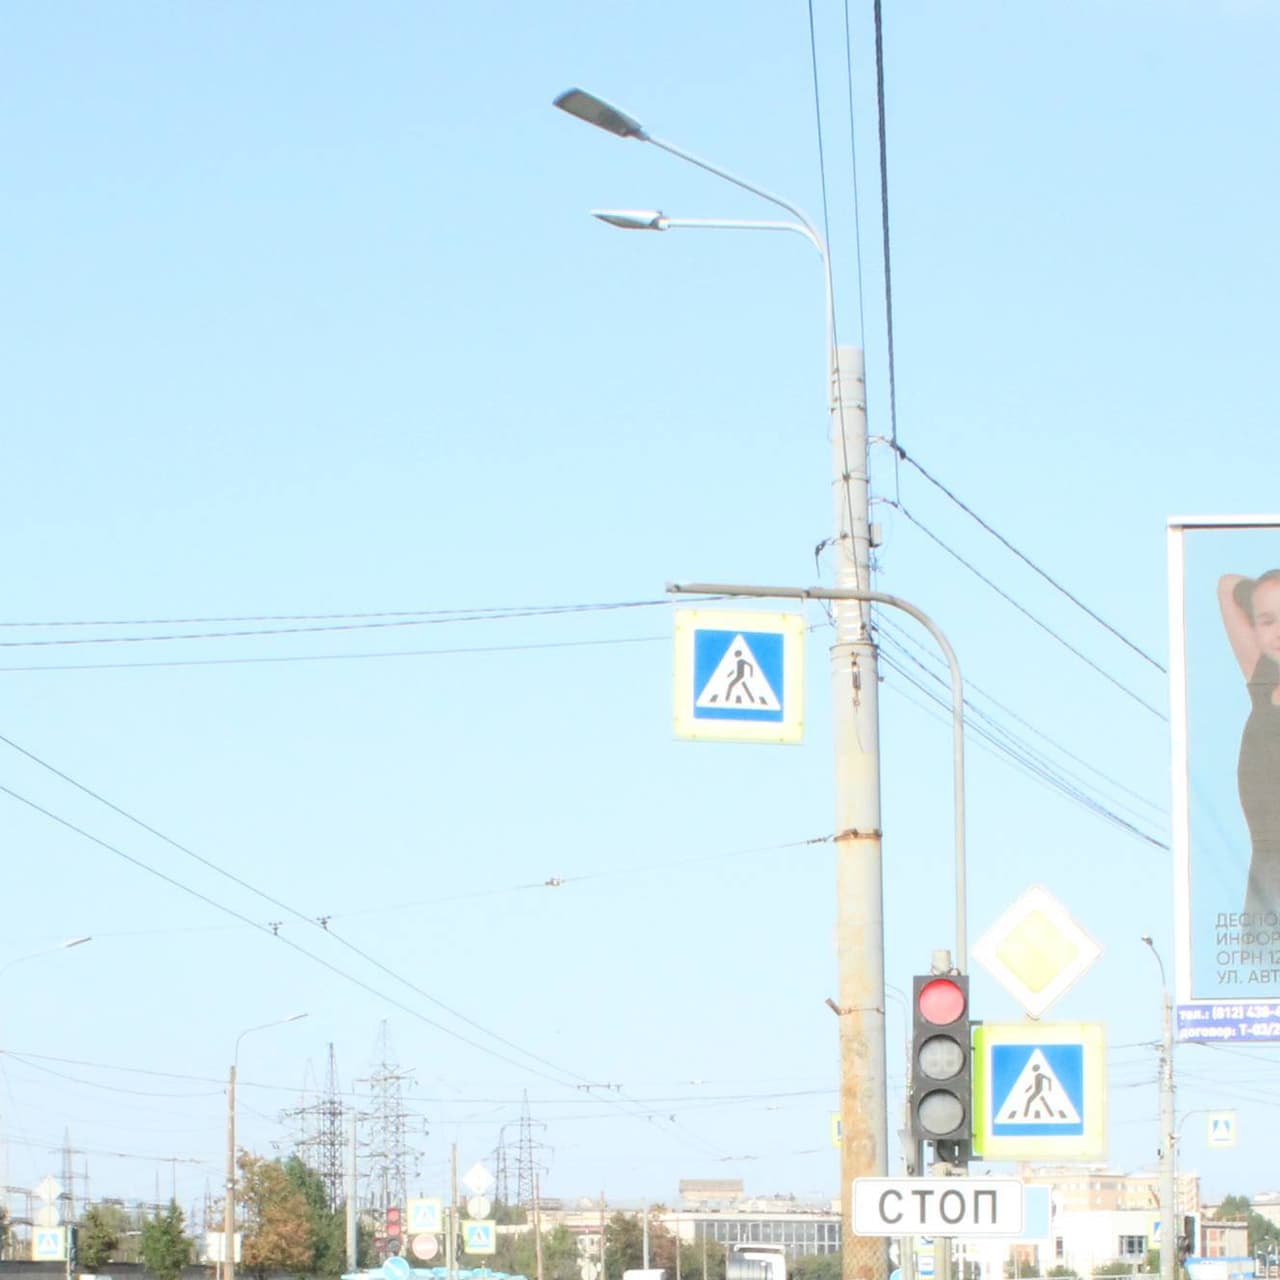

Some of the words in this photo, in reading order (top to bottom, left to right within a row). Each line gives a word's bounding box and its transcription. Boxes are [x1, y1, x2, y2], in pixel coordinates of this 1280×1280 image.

[1216, 950, 1263, 966] ОГРН
[1217, 969, 1242, 985] УЛ.
[879, 1189, 997, 1224] СТОП
